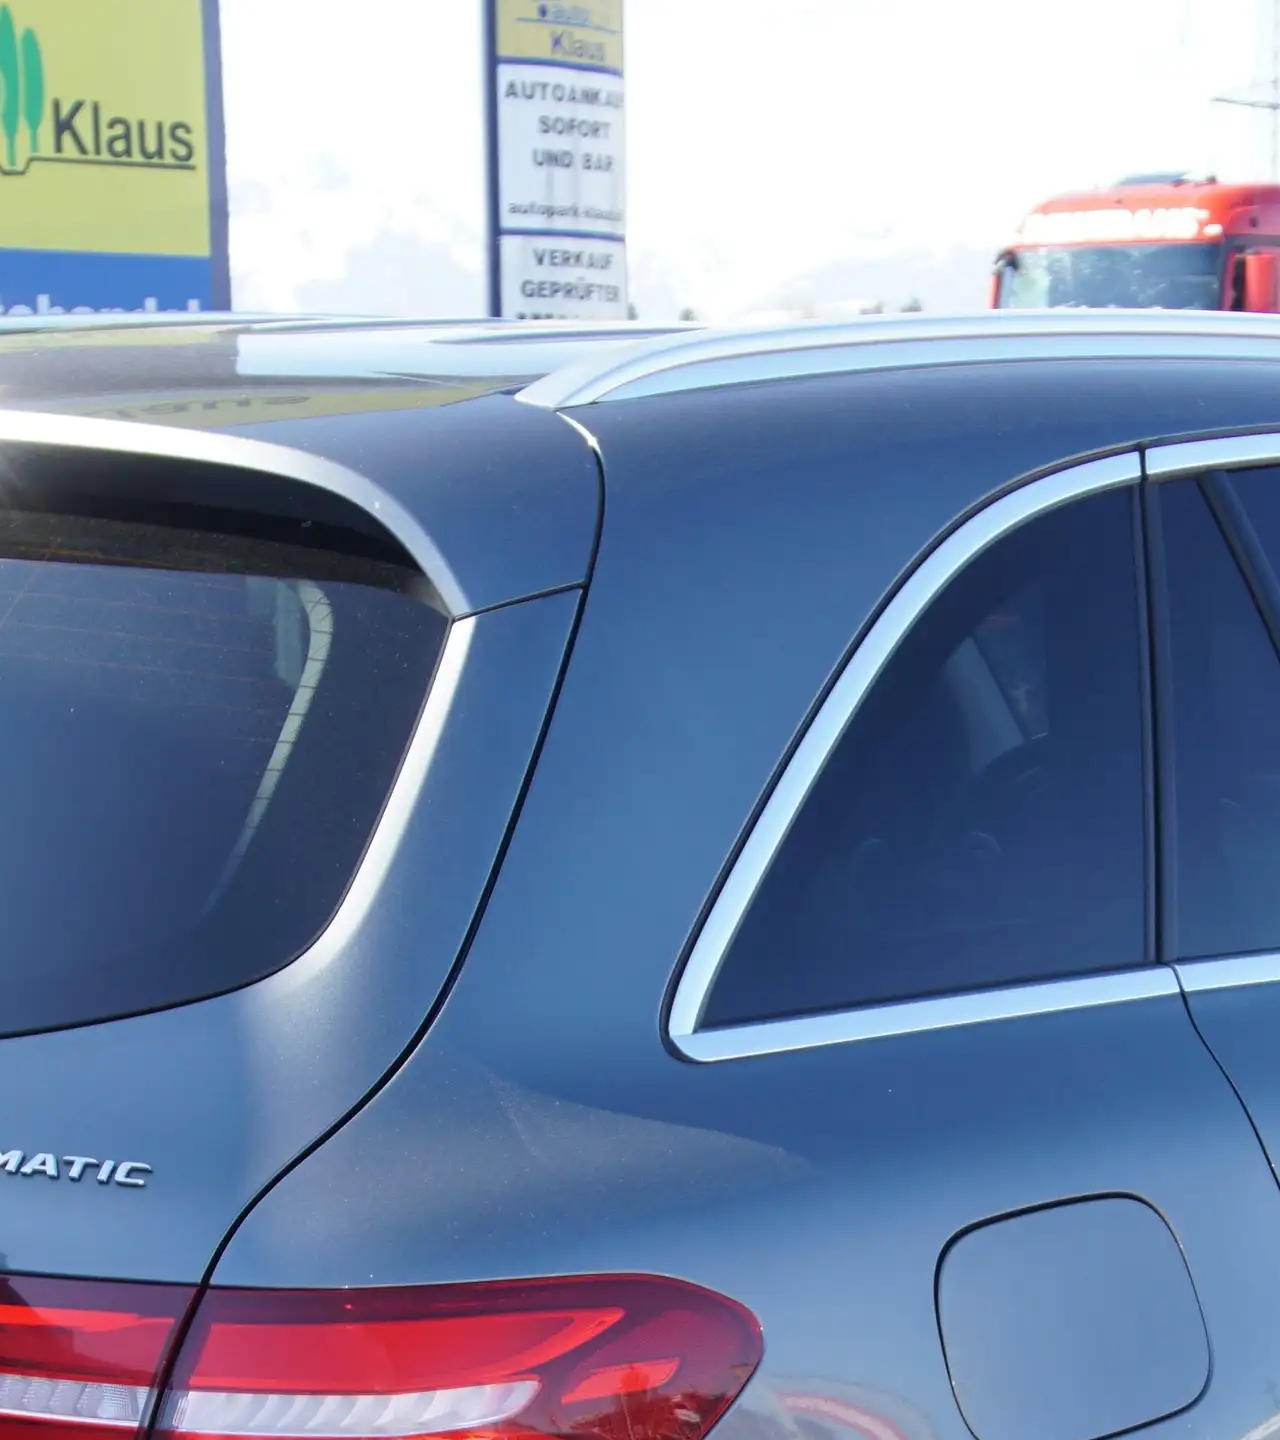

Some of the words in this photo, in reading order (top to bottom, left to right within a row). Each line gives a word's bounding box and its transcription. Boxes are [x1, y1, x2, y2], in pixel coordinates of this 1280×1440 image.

[53, 98, 196, 163] Klaus
[538, 115, 612, 139] SOFORT
[532, 148, 574, 168] UND
[532, 248, 614, 270] VERKAUF
